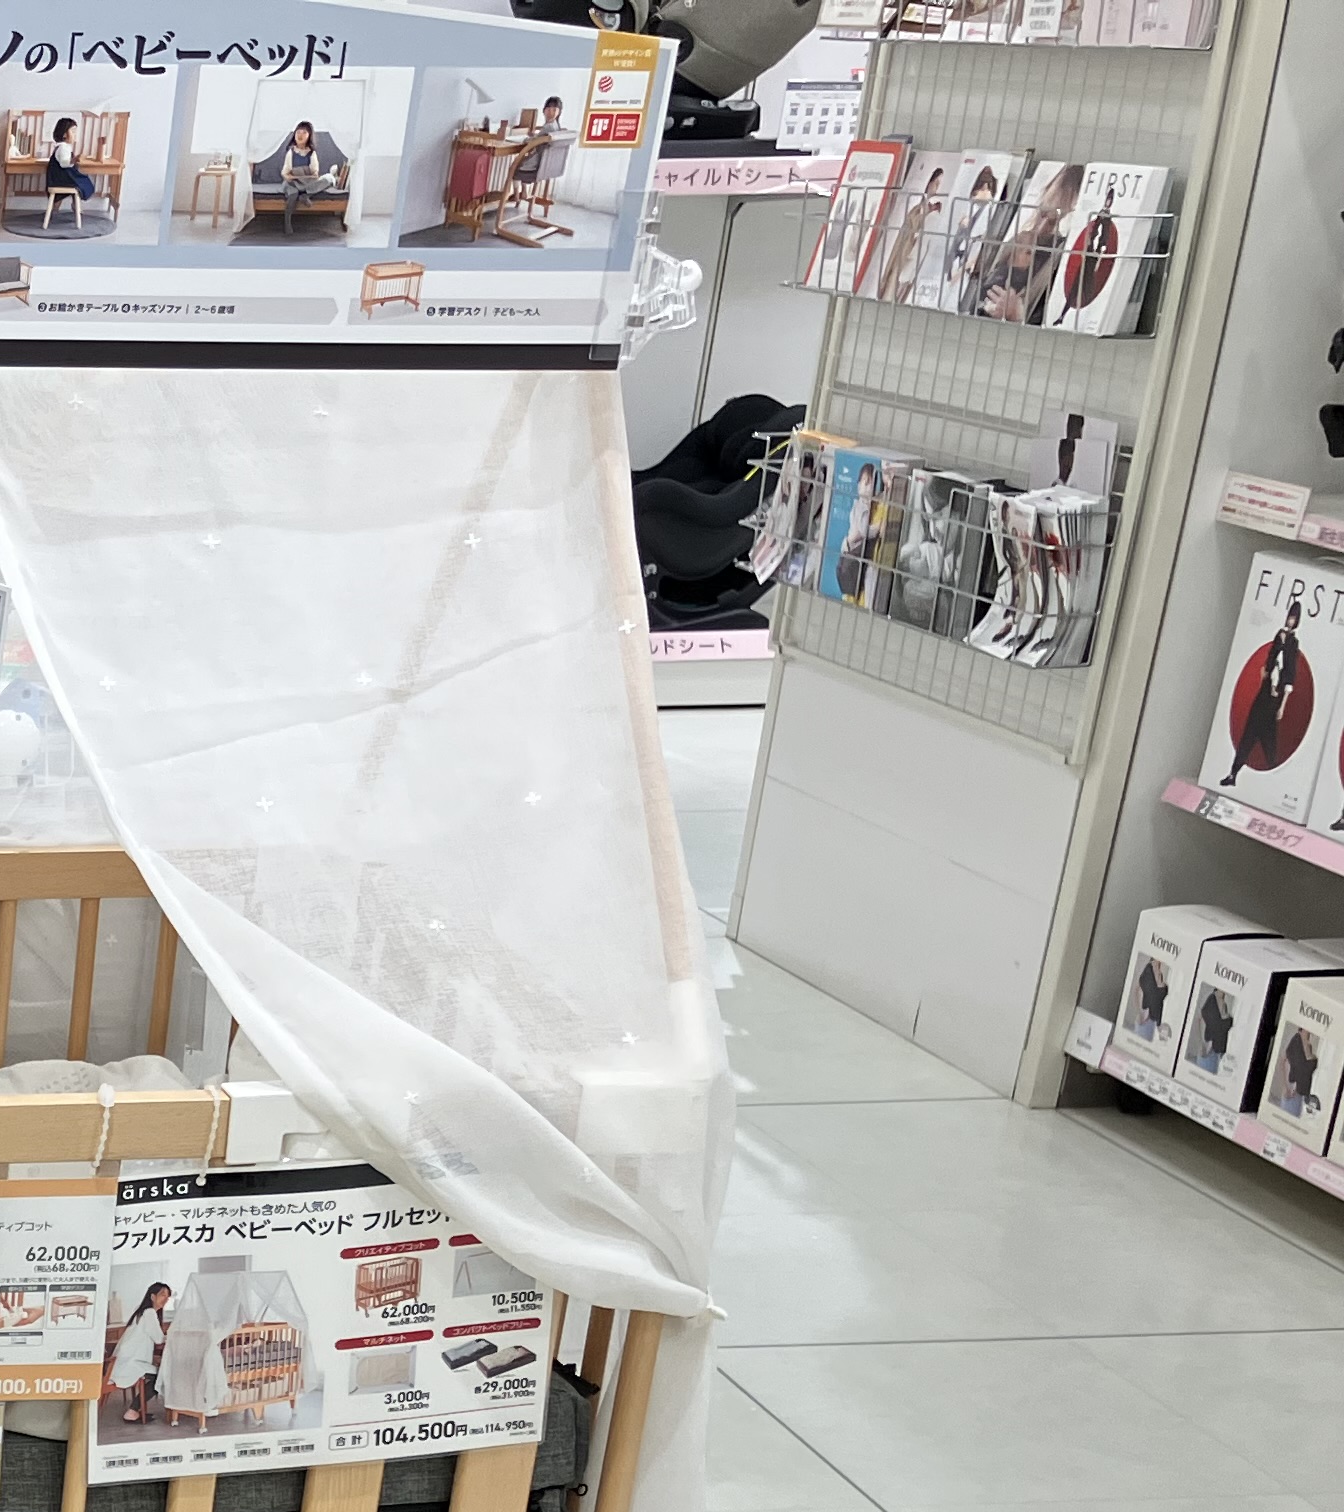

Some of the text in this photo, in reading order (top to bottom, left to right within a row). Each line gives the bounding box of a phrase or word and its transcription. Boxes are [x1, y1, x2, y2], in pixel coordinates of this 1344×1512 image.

[1084, 171, 1144, 199] FIRST
[123, 1178, 190, 1201] ärska
[112, 1207, 451, 1251] ファルスカ ベビーベッド フルセッ
[25, 1245, 101, 1262] 62,000円
[354, 1240, 426, 1257] クリエイティブコット
[33, 1262, 100, 1274] (税込68,200円)
[491, 1290, 544, 1307] 10,500円
[381, 1302, 436, 1319] 62,000円
[362, 1333, 407, 1347] マルチネット
[474, 1377, 536, 1395] 各29,000円
[384, 1389, 430, 1405] 3,000円
[335, 1420, 468, 1447] 合計 104,500円
